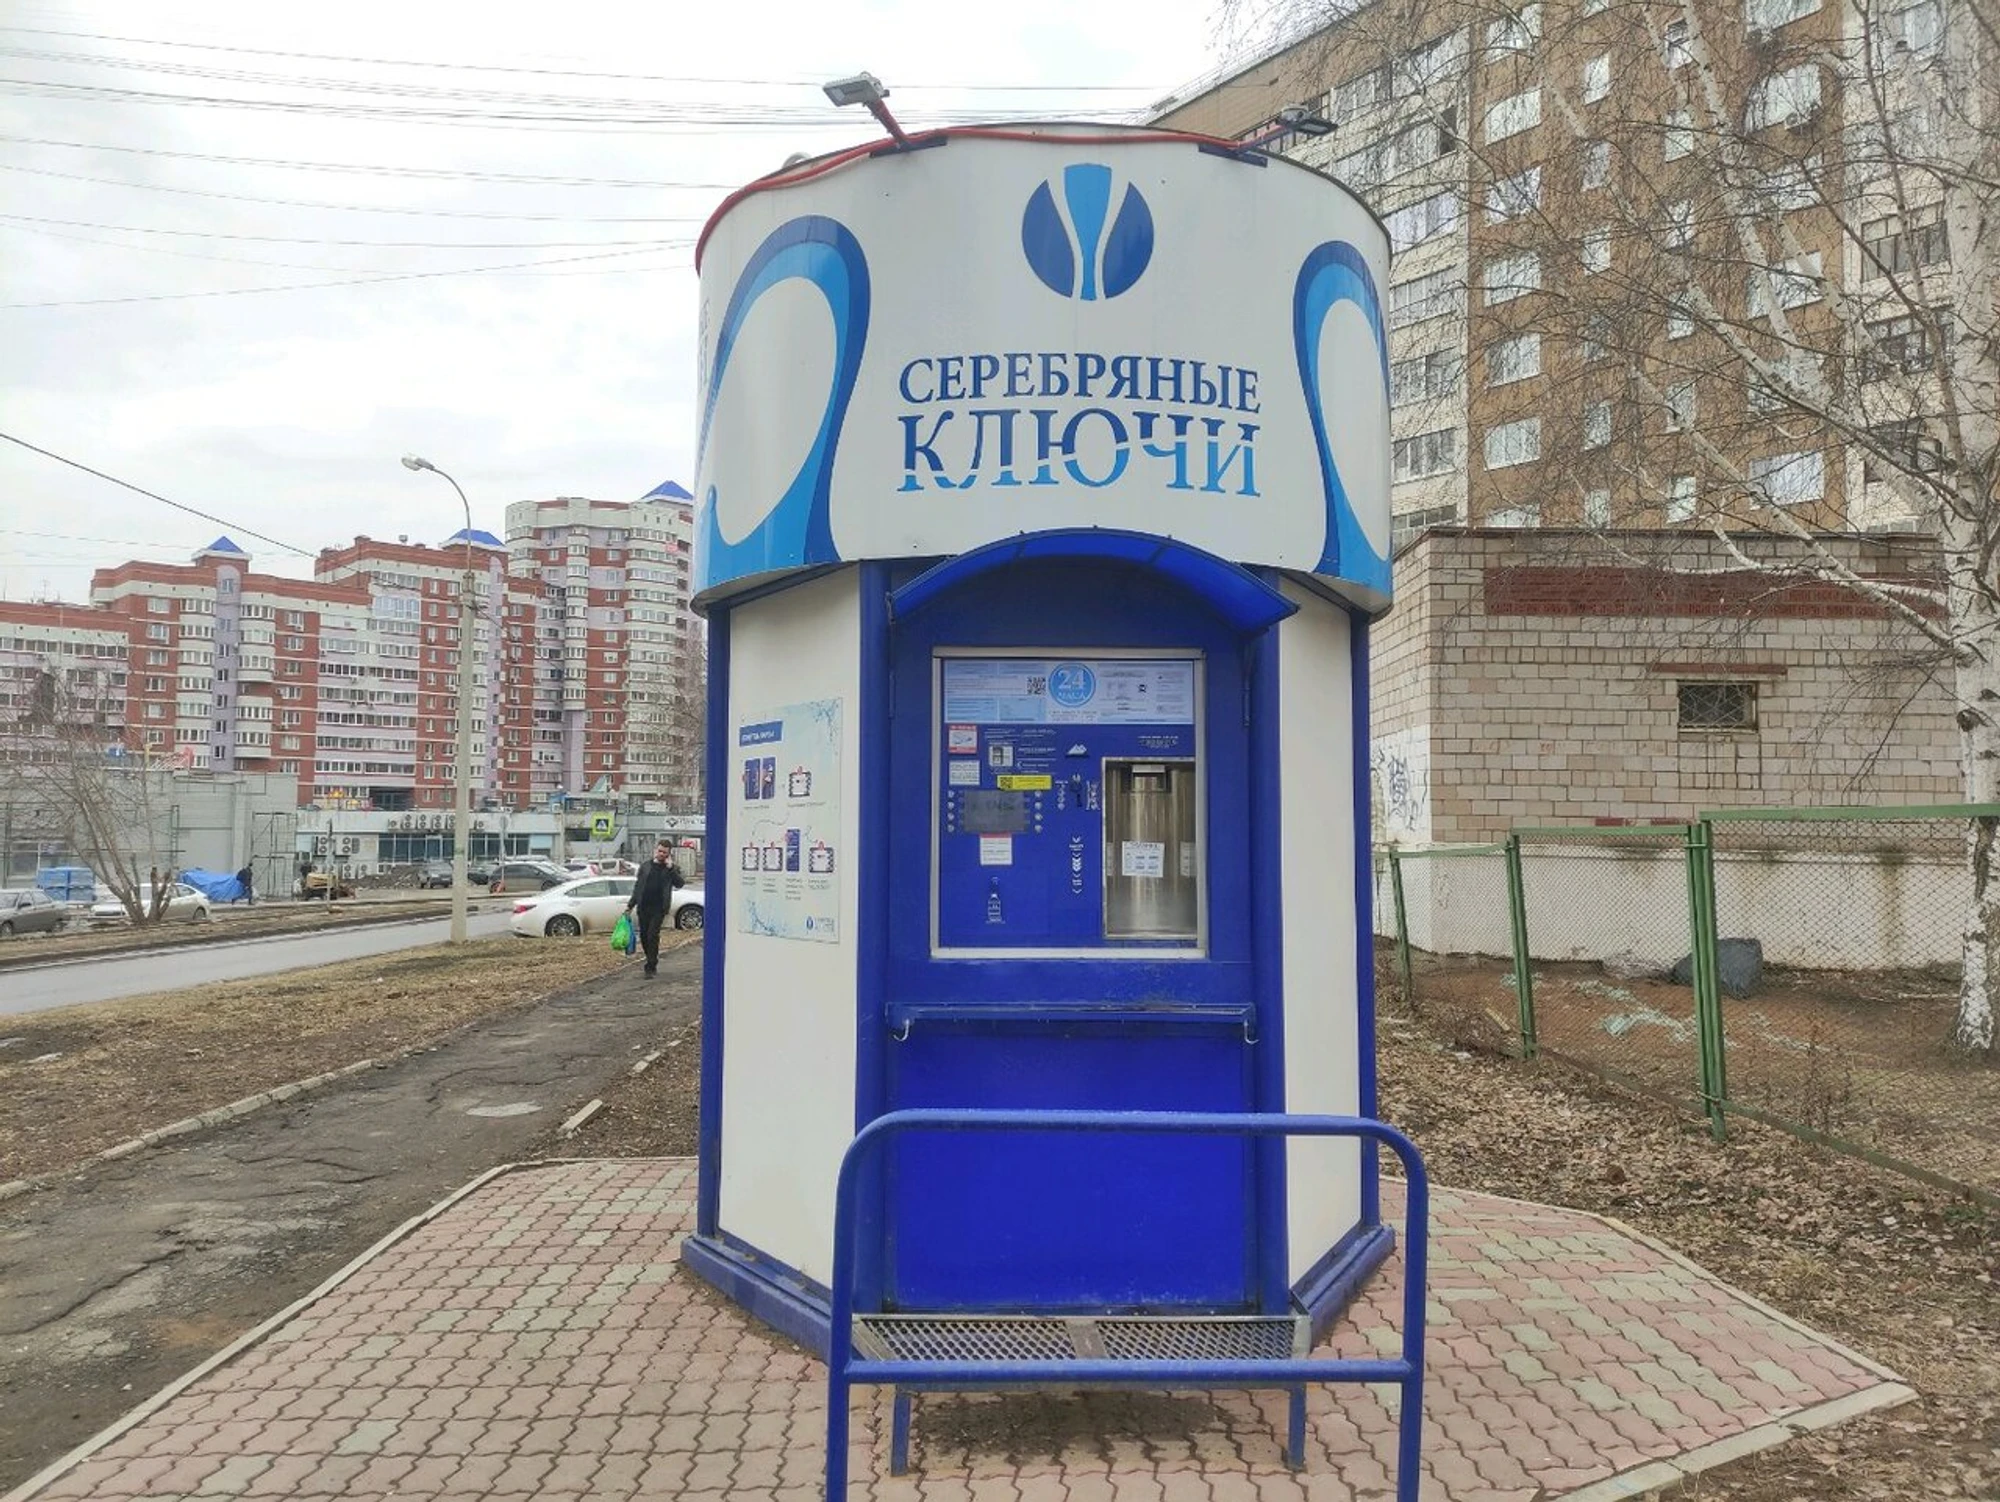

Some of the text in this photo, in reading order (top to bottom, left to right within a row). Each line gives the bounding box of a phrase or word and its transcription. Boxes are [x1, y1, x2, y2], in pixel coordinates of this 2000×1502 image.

[899, 353, 1261, 413] СЕРЕБРЯНЫЕ
[897, 408, 1260, 497] КЛЮЧИ
[1058, 670, 1086, 689] 24
